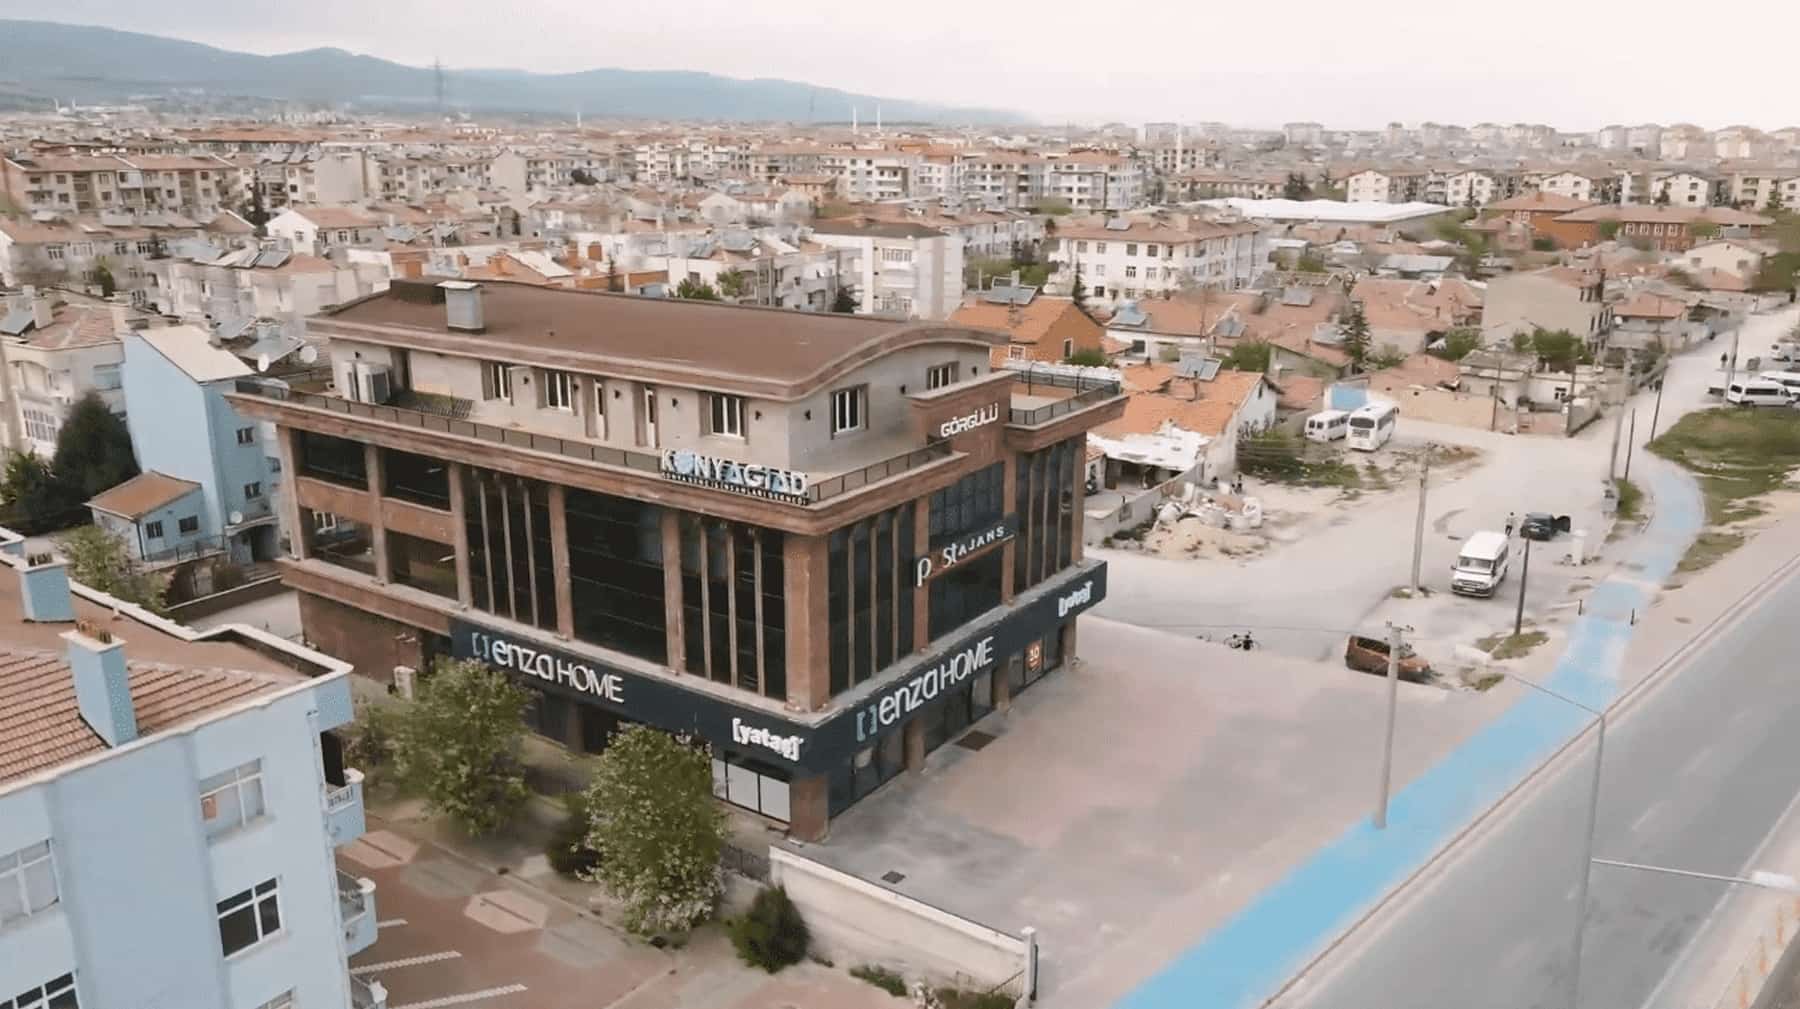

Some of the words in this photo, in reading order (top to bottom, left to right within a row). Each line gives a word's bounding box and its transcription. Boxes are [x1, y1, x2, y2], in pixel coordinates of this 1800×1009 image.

[940, 403, 999, 438] GÖRGÜLÜ
[916, 543, 957, 587] pst
[958, 525, 1004, 556] AJANS
[491, 639, 553, 679] enza
[555, 659, 625, 703] HOME
[878, 666, 938, 725] enza
[940, 636, 994, 690] HOME
